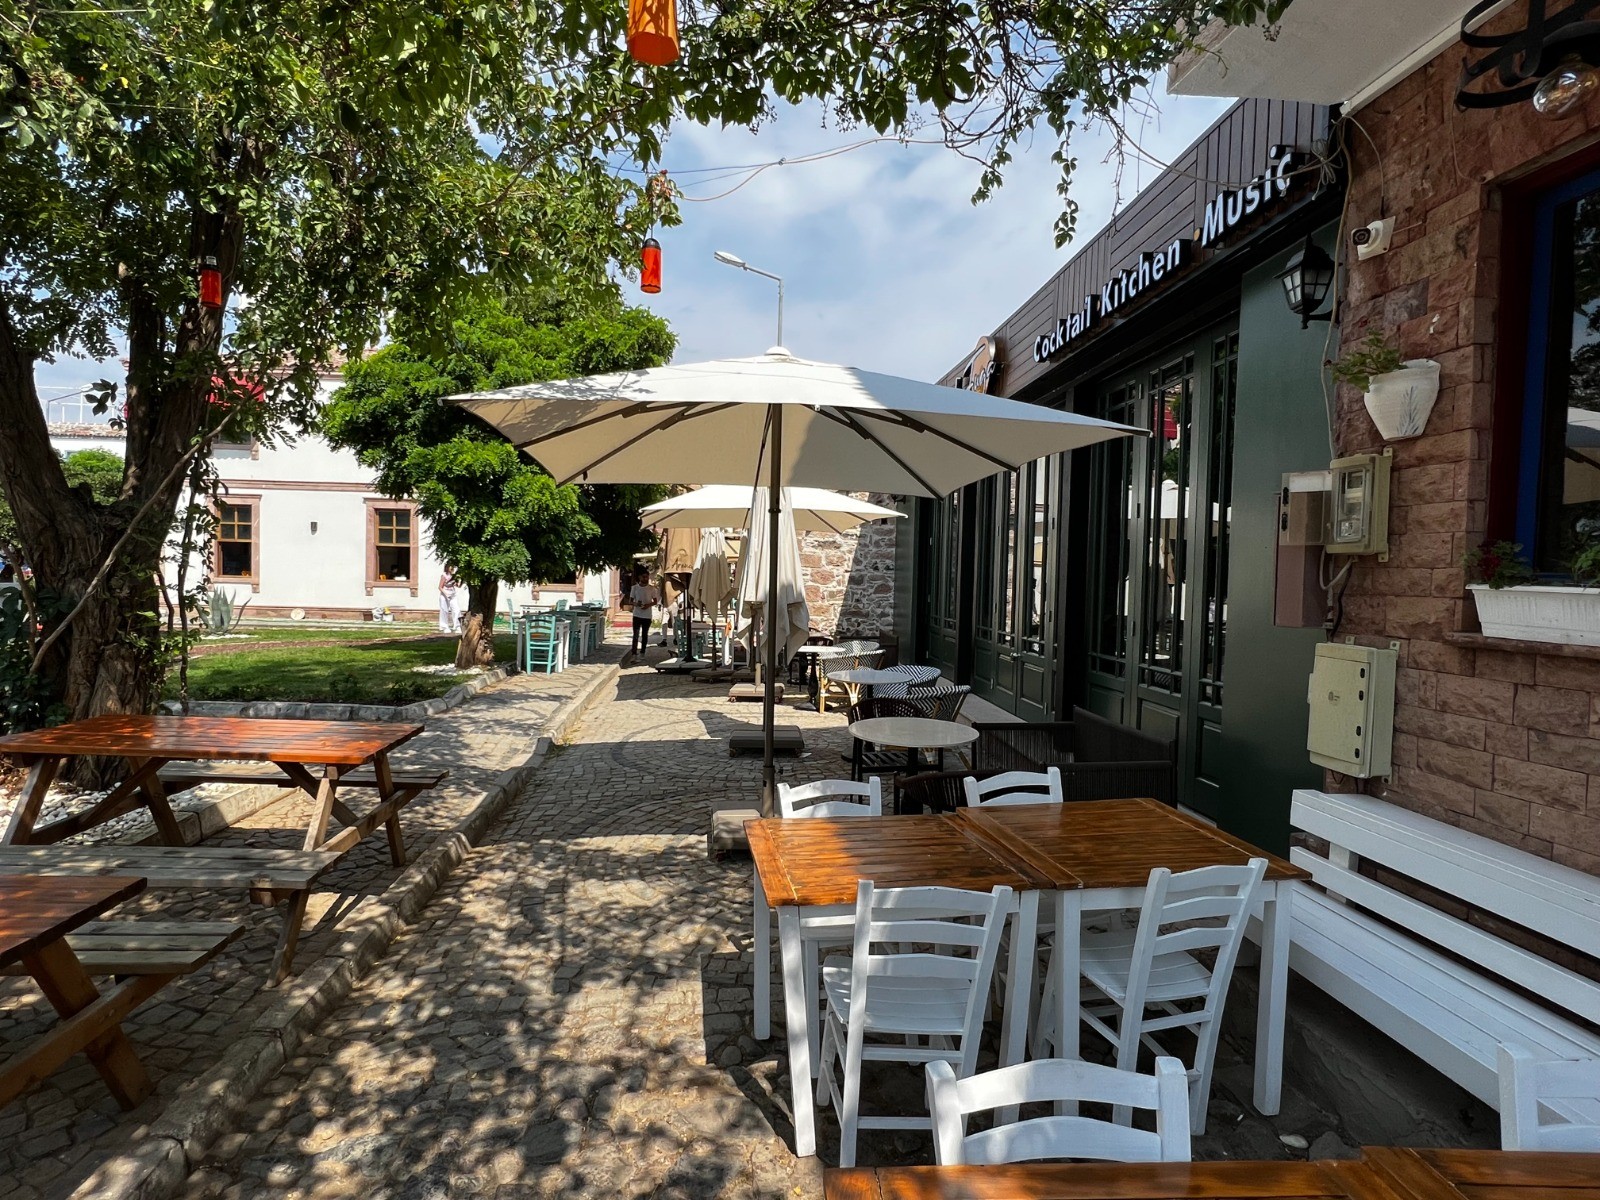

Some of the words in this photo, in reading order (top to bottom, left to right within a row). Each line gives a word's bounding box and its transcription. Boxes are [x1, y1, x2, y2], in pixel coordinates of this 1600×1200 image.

[1033, 295, 1091, 362] Cocktail
[1101, 239, 1180, 317] Kitchen
[1202, 146, 1292, 248] Music
